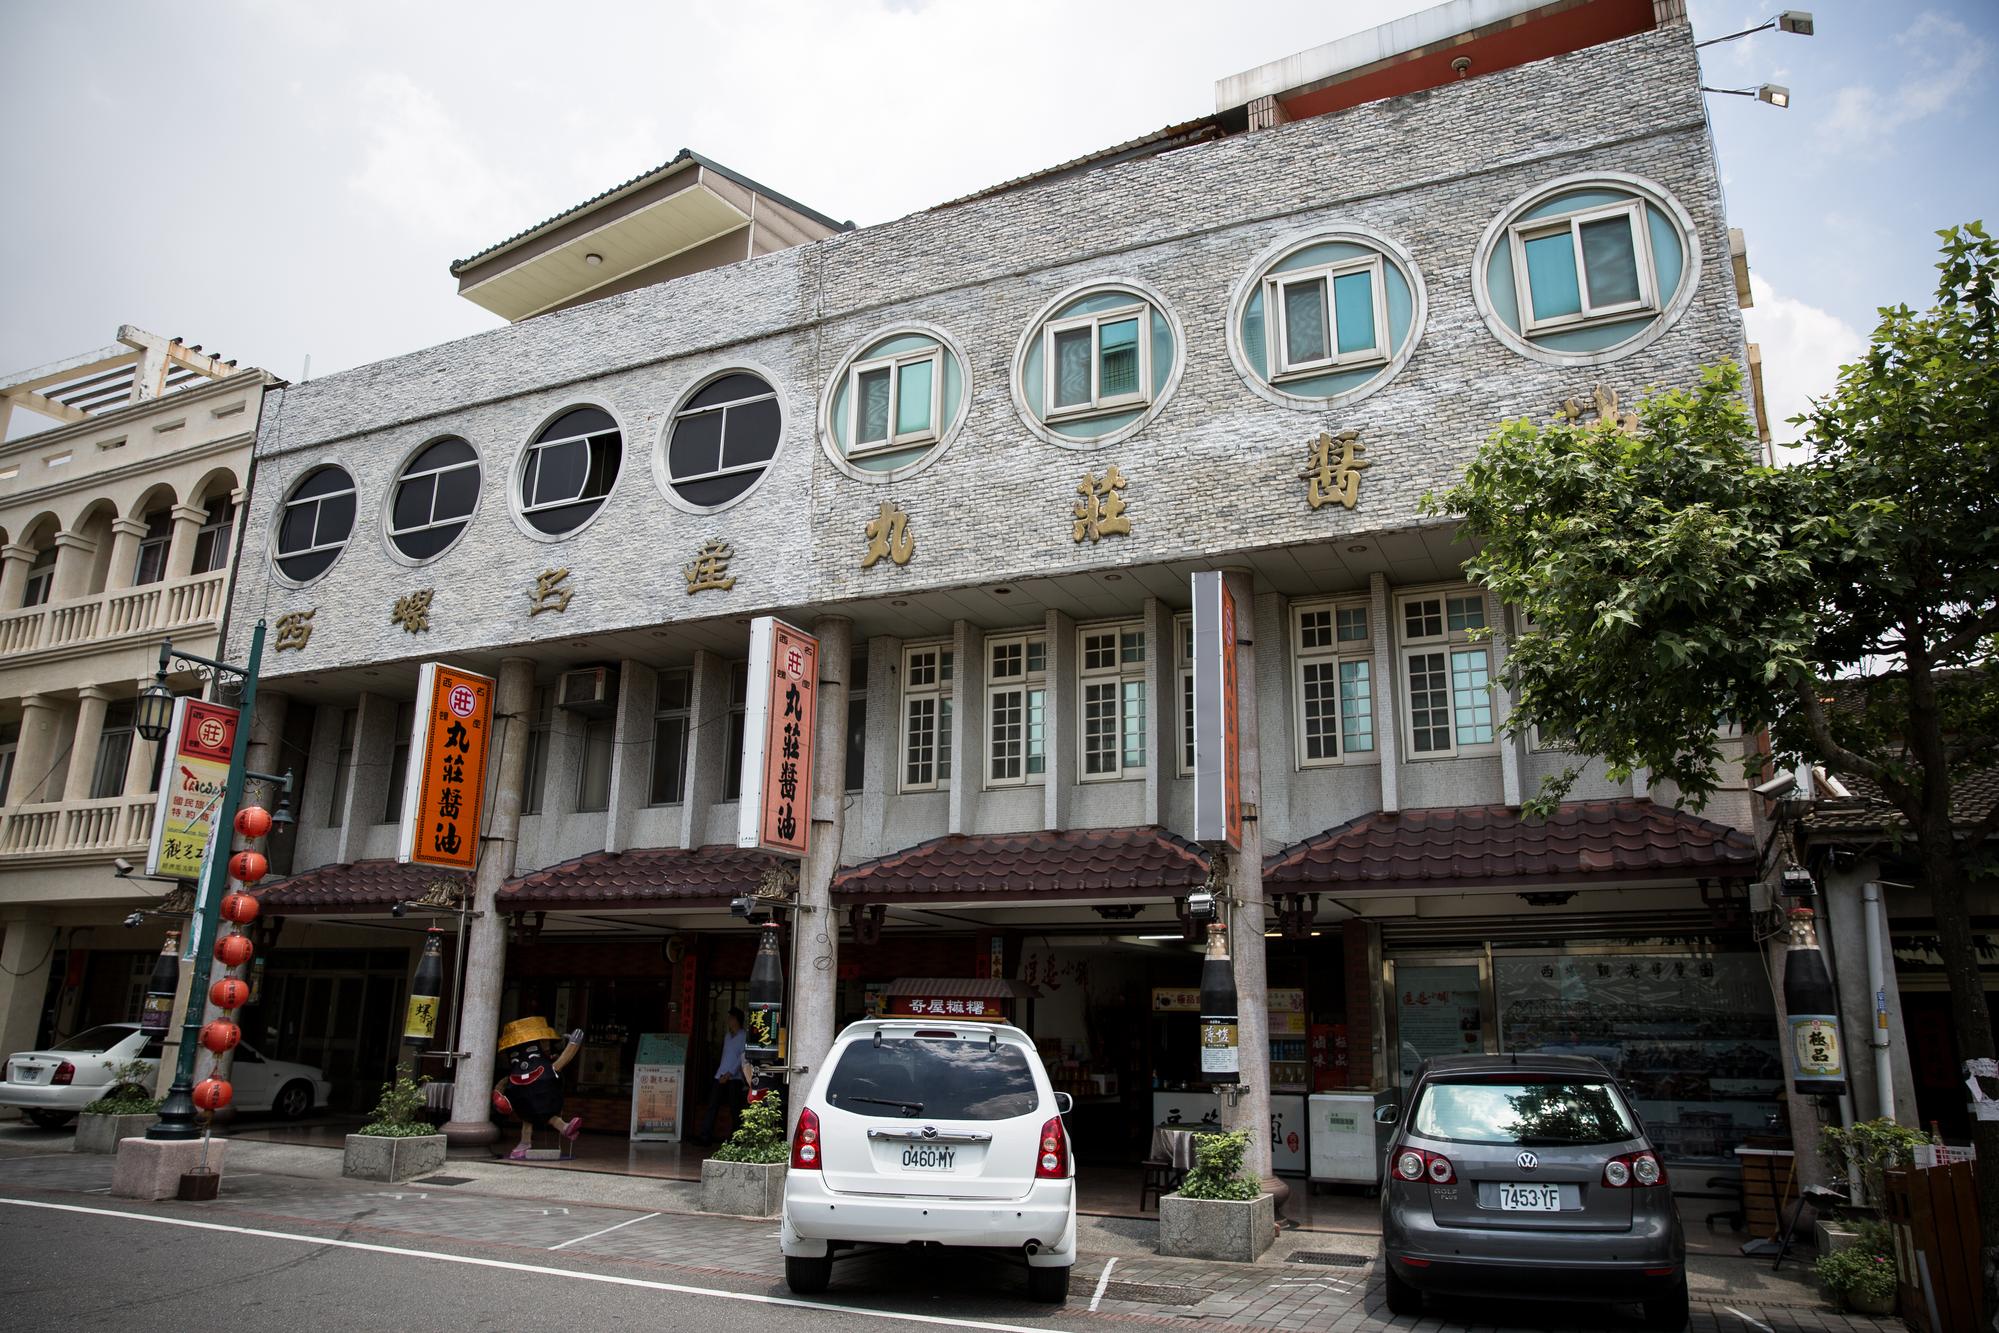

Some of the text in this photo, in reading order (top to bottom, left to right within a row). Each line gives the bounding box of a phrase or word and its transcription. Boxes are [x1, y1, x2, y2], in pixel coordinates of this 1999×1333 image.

[275, 536, 737, 652] 西螺名產
[203, 723, 221, 743] 莊
[434, 720, 470, 856] 丸莊醬油
[777, 683, 803, 841] 丸莊醬油
[1809, 1031, 1830, 1062] 極品
